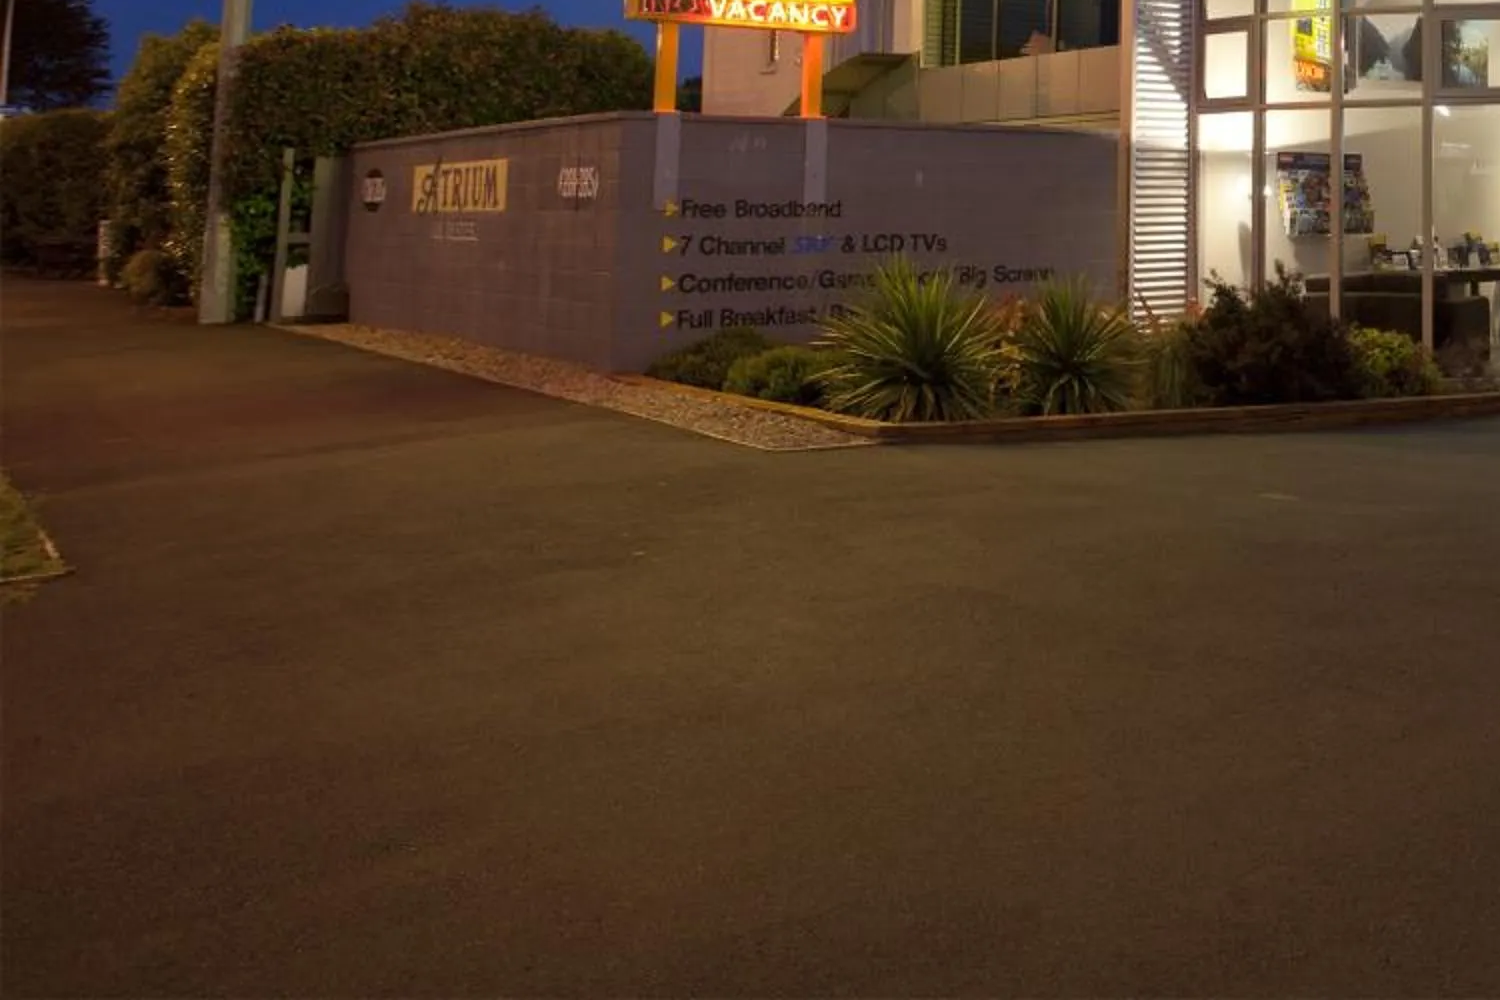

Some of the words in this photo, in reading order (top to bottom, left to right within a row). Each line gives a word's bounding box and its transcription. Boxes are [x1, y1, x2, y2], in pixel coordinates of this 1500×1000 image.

[416, 157, 498, 216] ATRIUM
[681, 199, 727, 219] Free
[735, 199, 842, 219] Broadband
[679, 235, 692, 257] 7
[699, 235, 786, 256] Channel
[841, 234, 855, 253] &
[862, 234, 904, 252] LCD
[910, 234, 947, 252] TVs
[677, 310, 713, 330] Full
